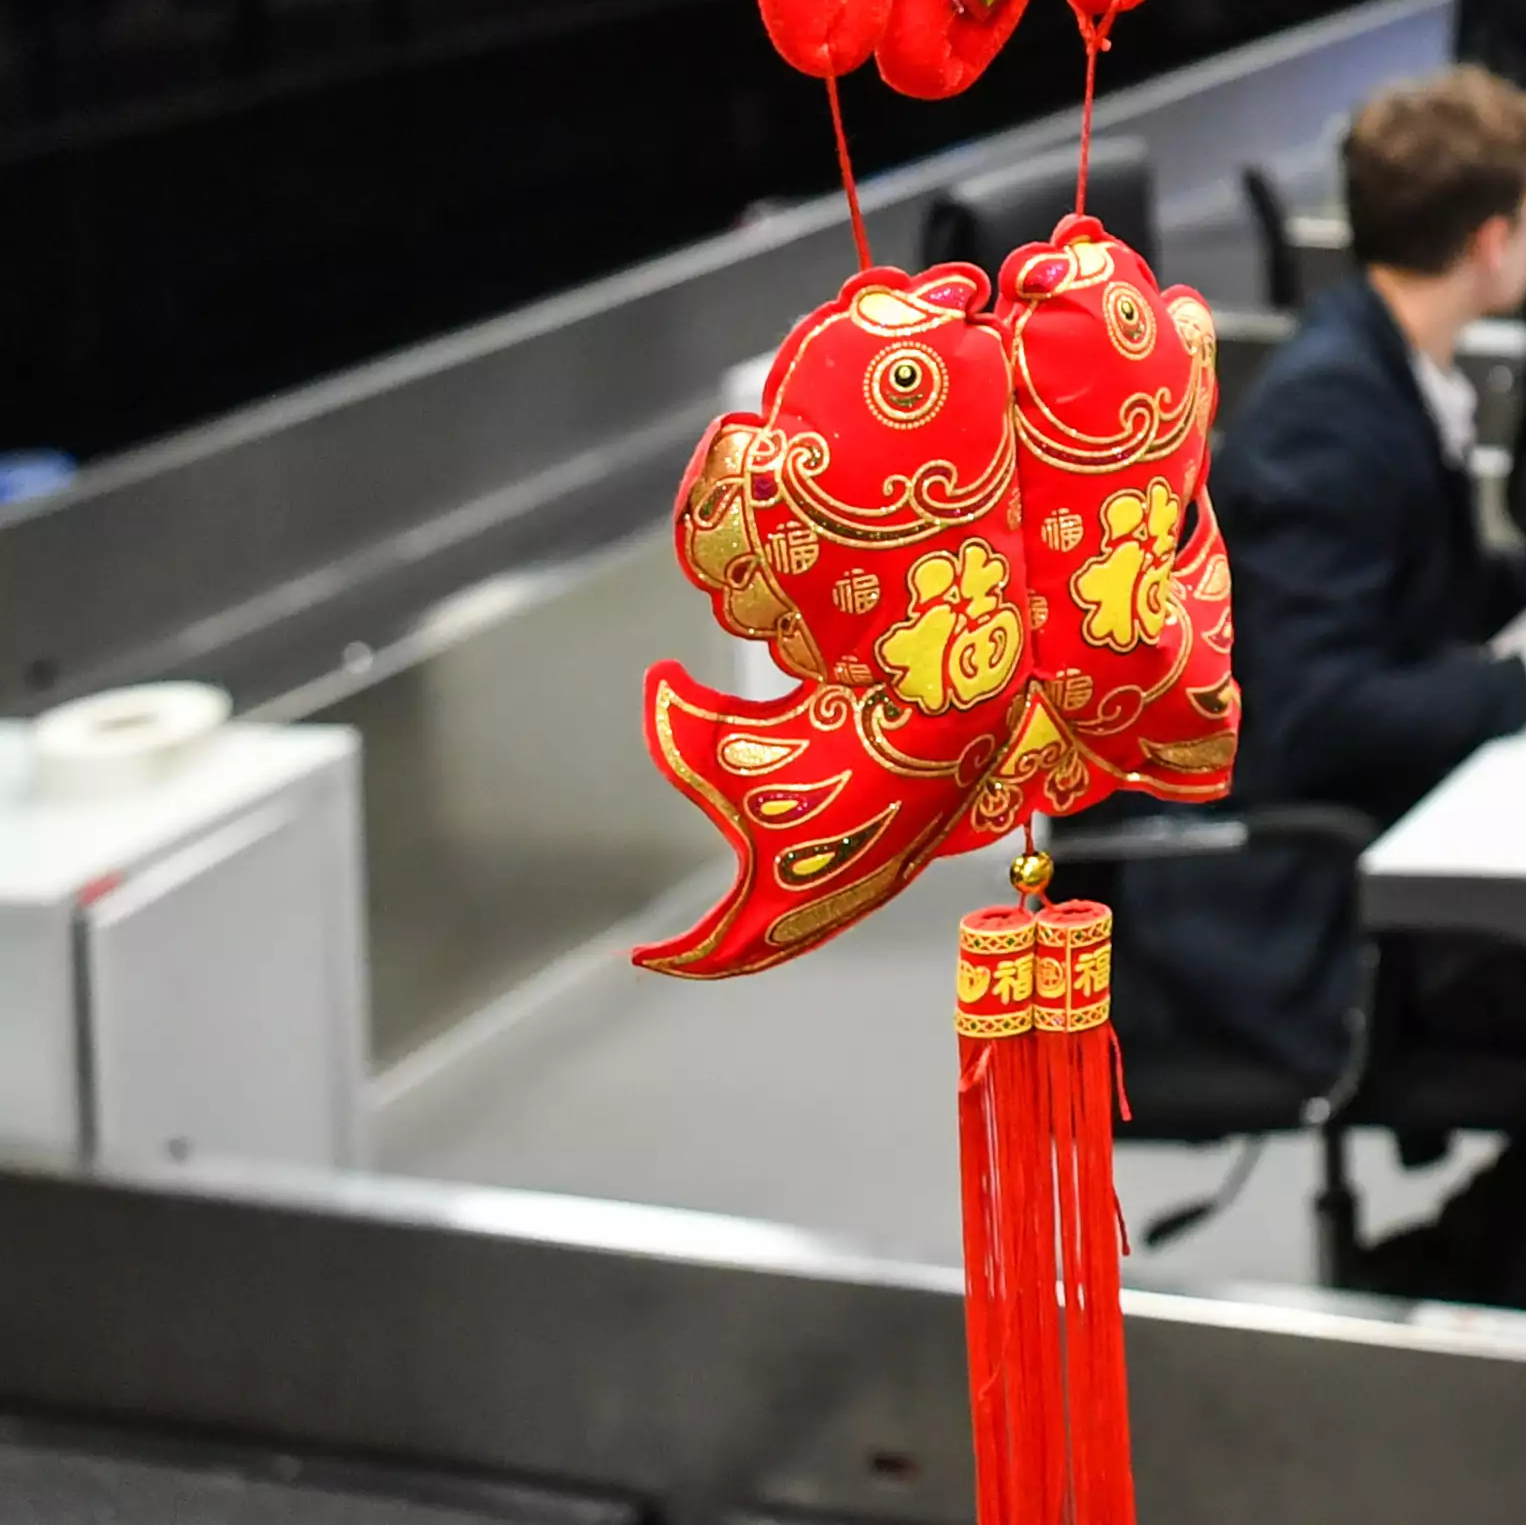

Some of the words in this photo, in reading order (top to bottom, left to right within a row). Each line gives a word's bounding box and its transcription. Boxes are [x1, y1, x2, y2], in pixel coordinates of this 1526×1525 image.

[764, 520, 820, 575] 福
[1041, 507, 1084, 553] 福
[832, 567, 881, 616] 福
[1069, 475, 1181, 653] 福
[874, 536, 1025, 716] 福
[992, 953, 1036, 1005] 福
[1073, 942, 1112, 999] 福
